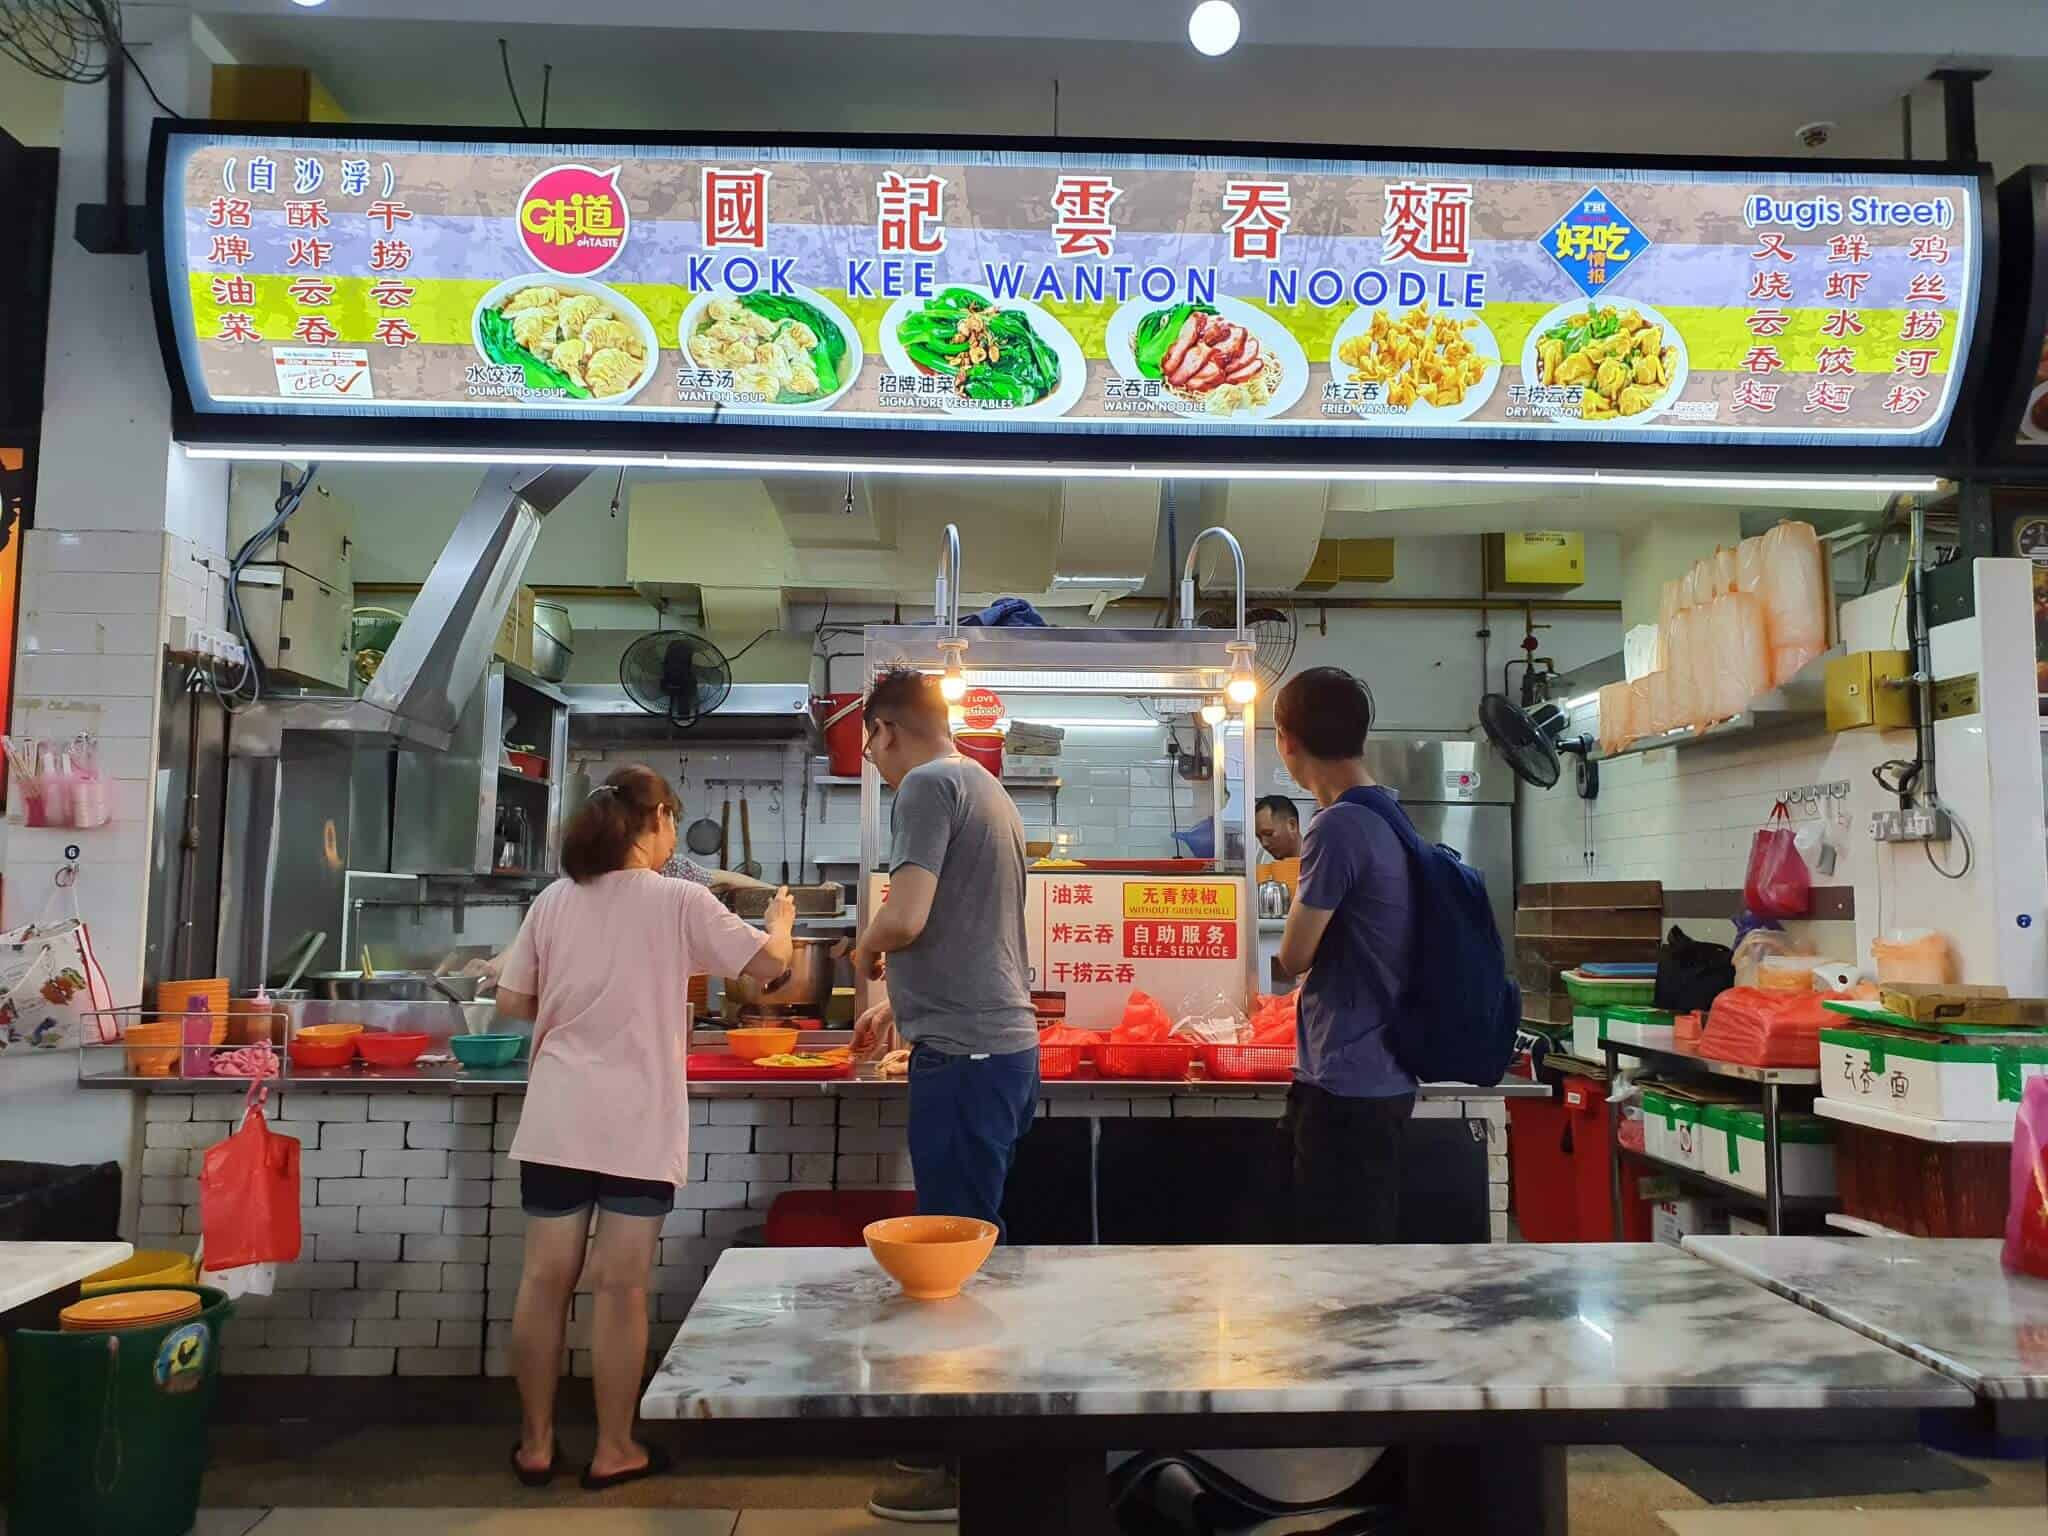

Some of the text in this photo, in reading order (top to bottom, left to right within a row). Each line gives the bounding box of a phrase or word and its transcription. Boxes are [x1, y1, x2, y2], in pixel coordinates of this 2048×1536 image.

[1746, 198, 1953, 228] (Bugis Street)
[1556, 222, 1631, 261] 好吃
[208, 198, 262, 343] 招牌油菜
[286, 200, 337, 344] 酥炸云吞
[367, 202, 417, 346] 干捞云吞
[689, 256, 1485, 308] KOK KEE WANTON NOODLE
[1884, 236, 1948, 413] 鸡丝捞河粉
[467, 365, 524, 384] 水饺汤
[678, 369, 735, 388] 云吞汤
[469, 386, 568, 399] DUMPLING SOUP
[879, 375, 954, 394] 招牌油菜
[1106, 379, 1161, 397] 云吞面
[1322, 382, 1379, 401] 炸云吞
[1508, 384, 1583, 404] 干捞云吞
[678, 391, 767, 402] WANTON SOUP
[879, 396, 1014, 410] SIGNATURE VEGETABLES
[1104, 401, 1206, 413] WANTON NOODLE
[1321, 403, 1408, 415] FRIED WANTON
[1505, 406, 1584, 417] DRY WANTON
[1052, 883, 1093, 905] 油菜
[1143, 887, 1218, 905] 无青辣椒
[1128, 906, 1169, 915] WITHOUT
[1052, 923, 1114, 945] 炸云吞
[1134, 924, 1226, 945] 自助服务
[1132, 945, 1230, 957] SELF-SERVICE
[1051, 962, 1136, 984] 干捞云吞
